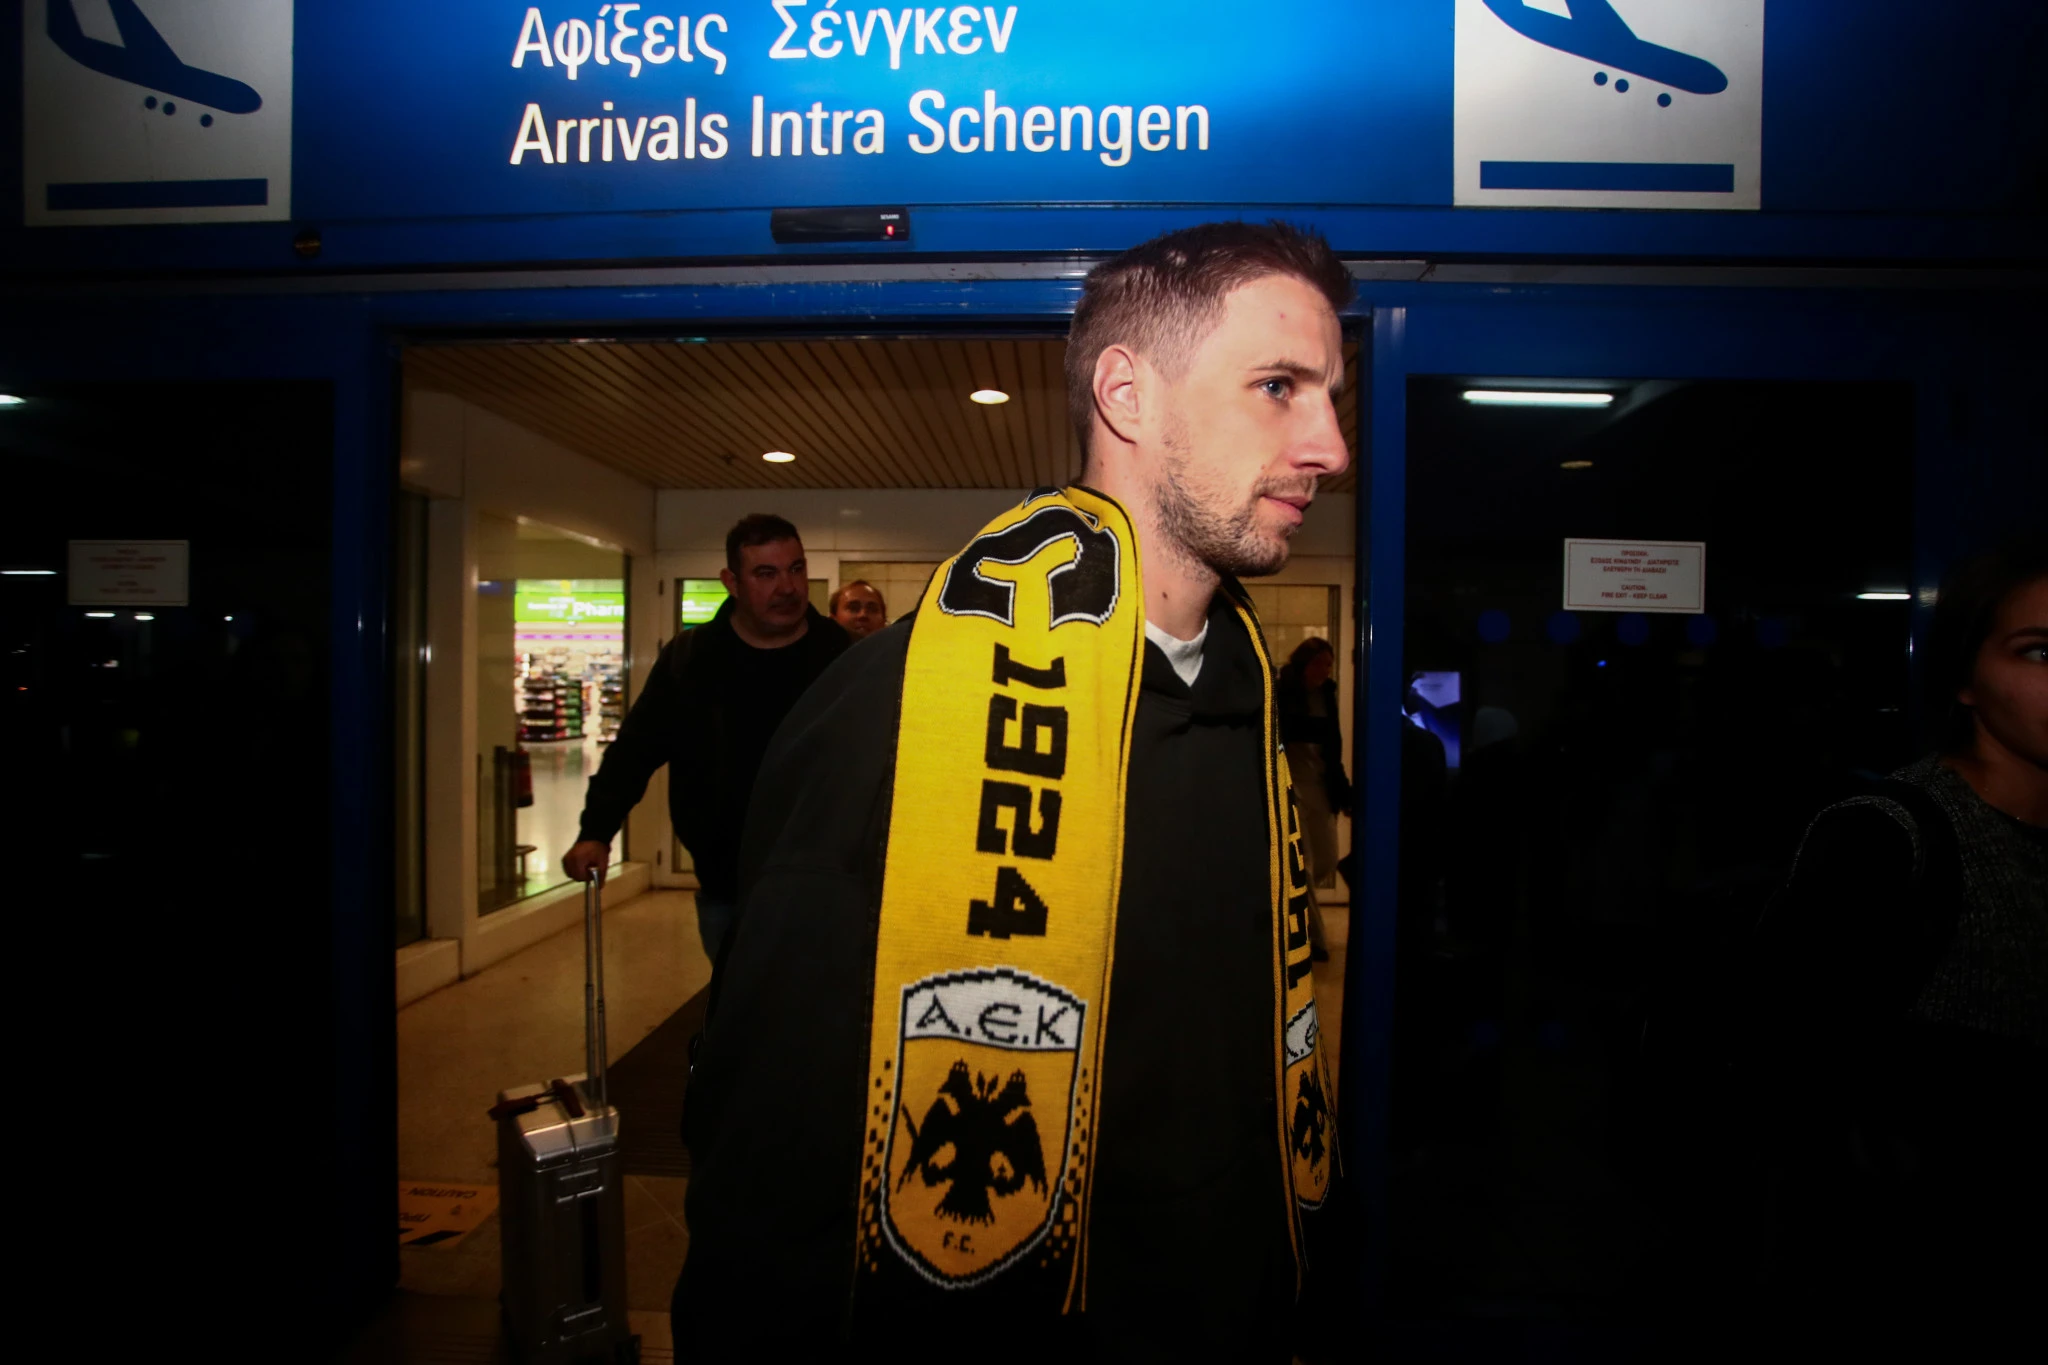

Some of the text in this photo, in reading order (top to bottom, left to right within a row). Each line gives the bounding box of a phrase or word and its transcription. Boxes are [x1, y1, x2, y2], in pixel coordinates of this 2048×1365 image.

[511, 0, 1019, 81] Αφίξεις Σένγκεν
[509, 89, 1210, 167] Arrivals Intra Schengen
[966, 642, 1069, 940] 1924
